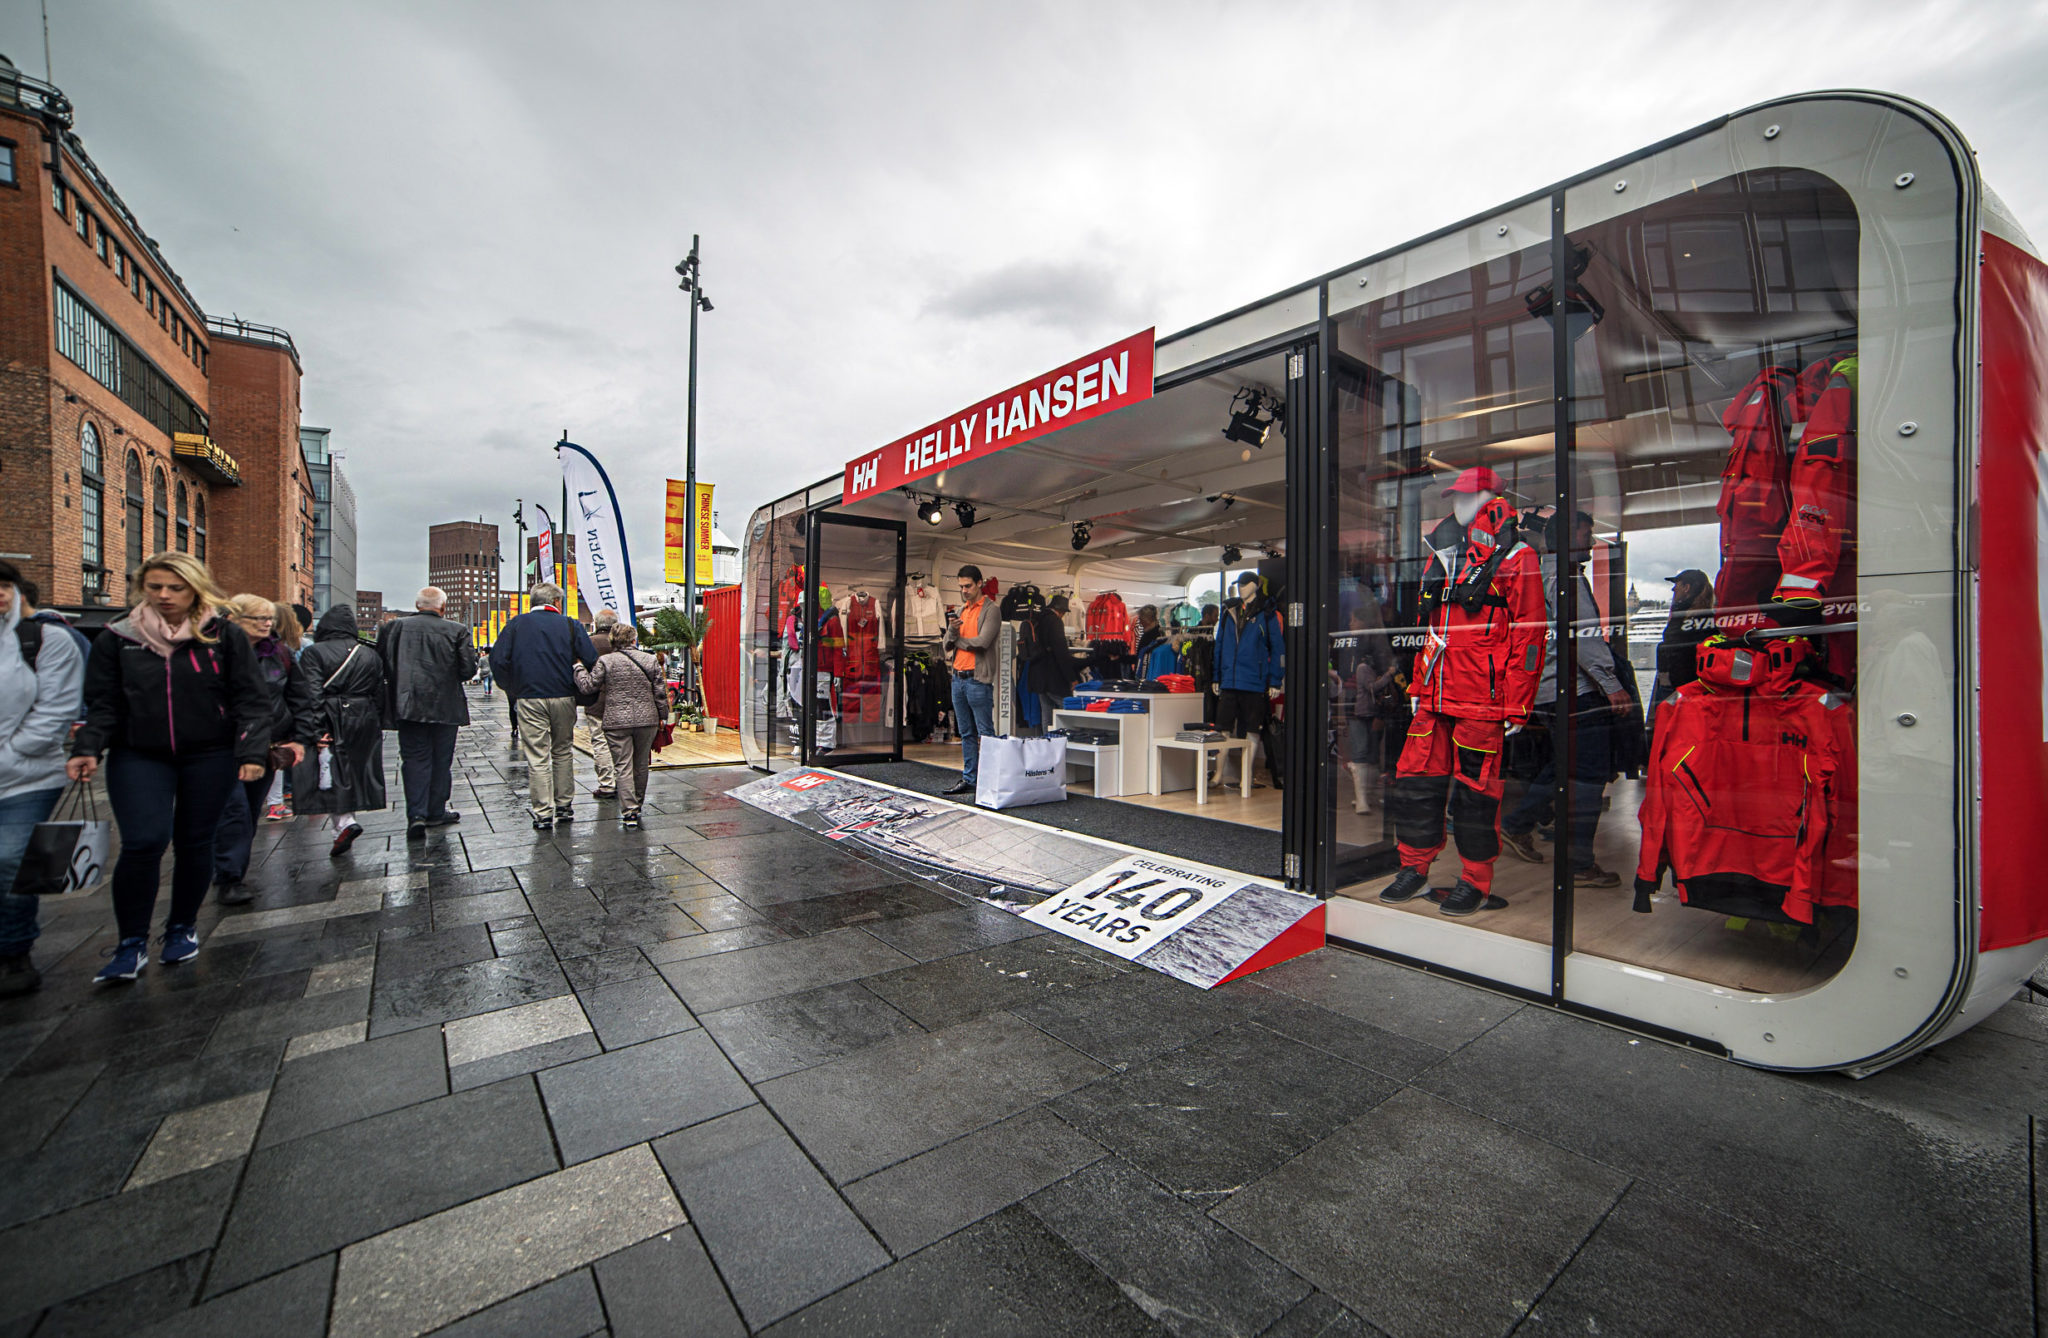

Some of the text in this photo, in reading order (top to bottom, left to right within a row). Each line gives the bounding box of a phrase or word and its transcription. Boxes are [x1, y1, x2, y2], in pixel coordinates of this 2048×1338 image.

[851, 350, 1129, 495] HH HELLY HANSEN
[700, 493, 710, 521] CHINESE
[700, 521, 710, 550] SUMMER
[1001, 628, 1010, 719] HELLY HANSEN
[1782, 732, 1808, 748] HH
[1132, 859, 1227, 888] CELEBRATING
[1084, 870, 1204, 921] 140
[1048, 898, 1151, 944] YEARS
